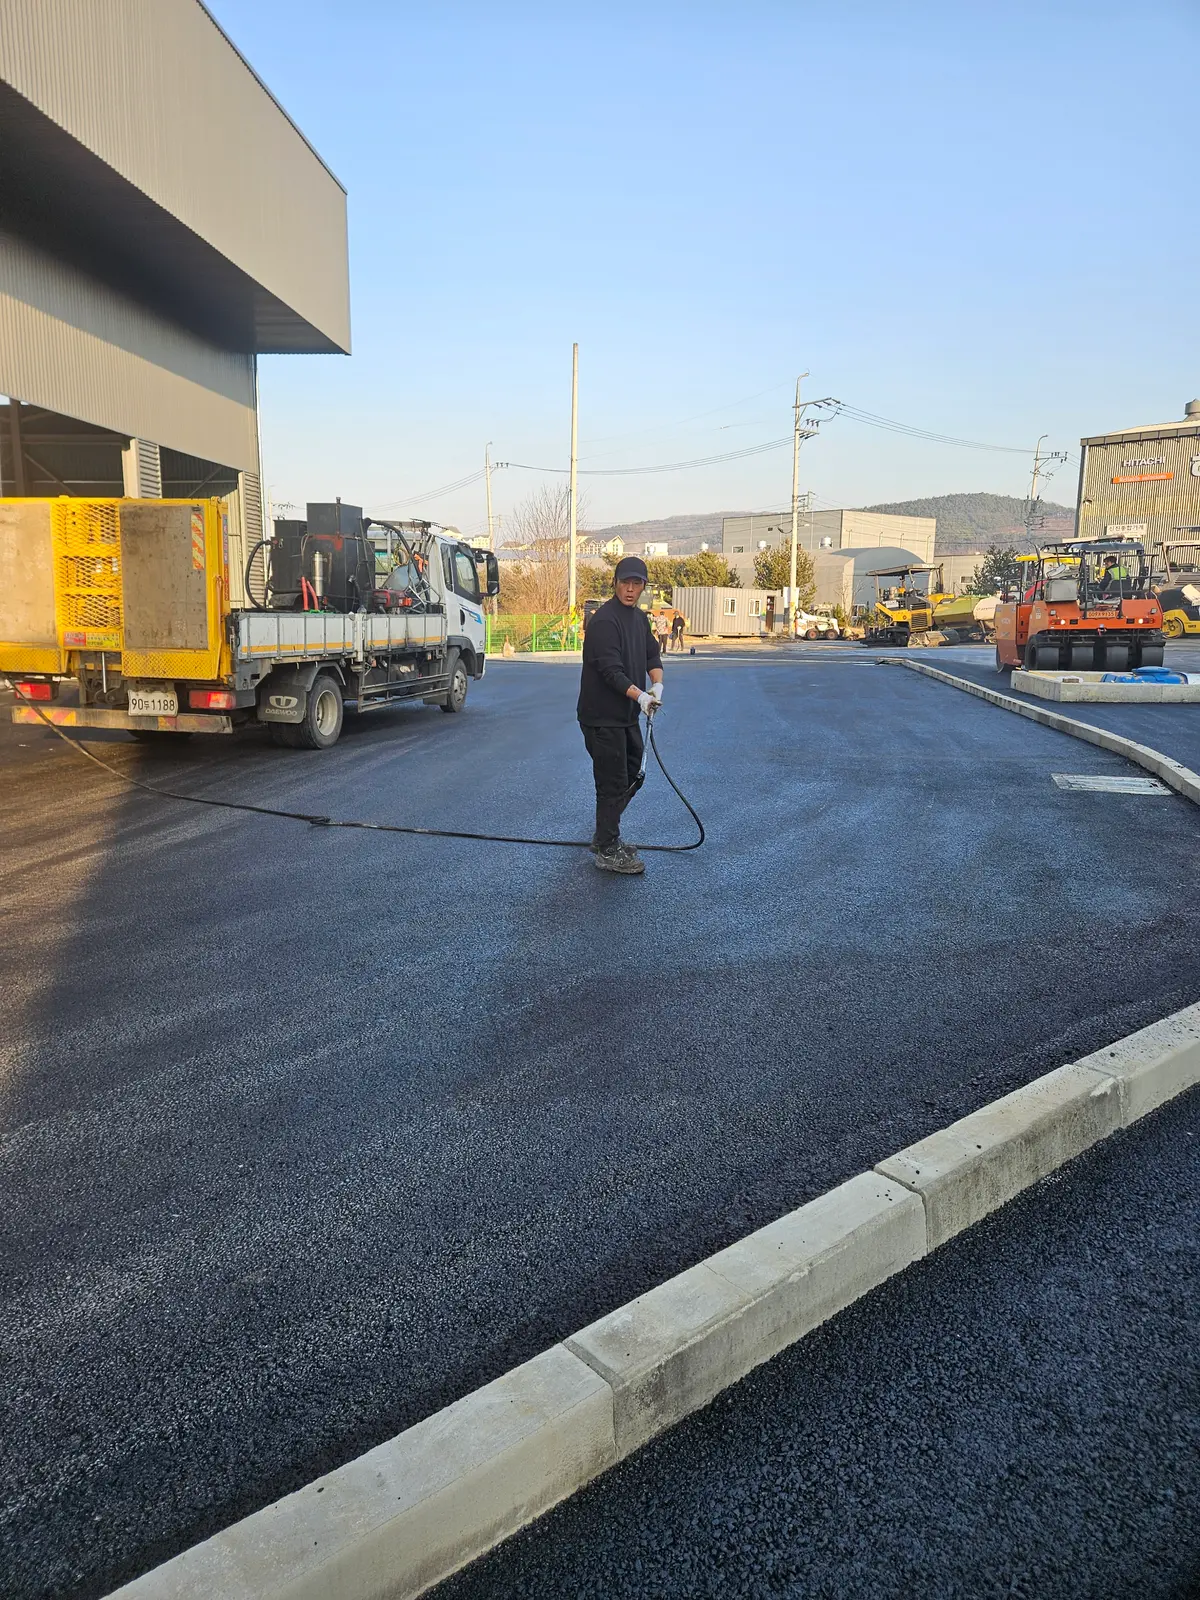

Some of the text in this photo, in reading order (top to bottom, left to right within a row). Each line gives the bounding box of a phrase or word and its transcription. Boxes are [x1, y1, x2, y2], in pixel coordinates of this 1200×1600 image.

[1123, 456, 1166, 467] HITACHI
[131, 698, 175, 711] 90두1188
[265, 708, 298, 717] DAEWOO
